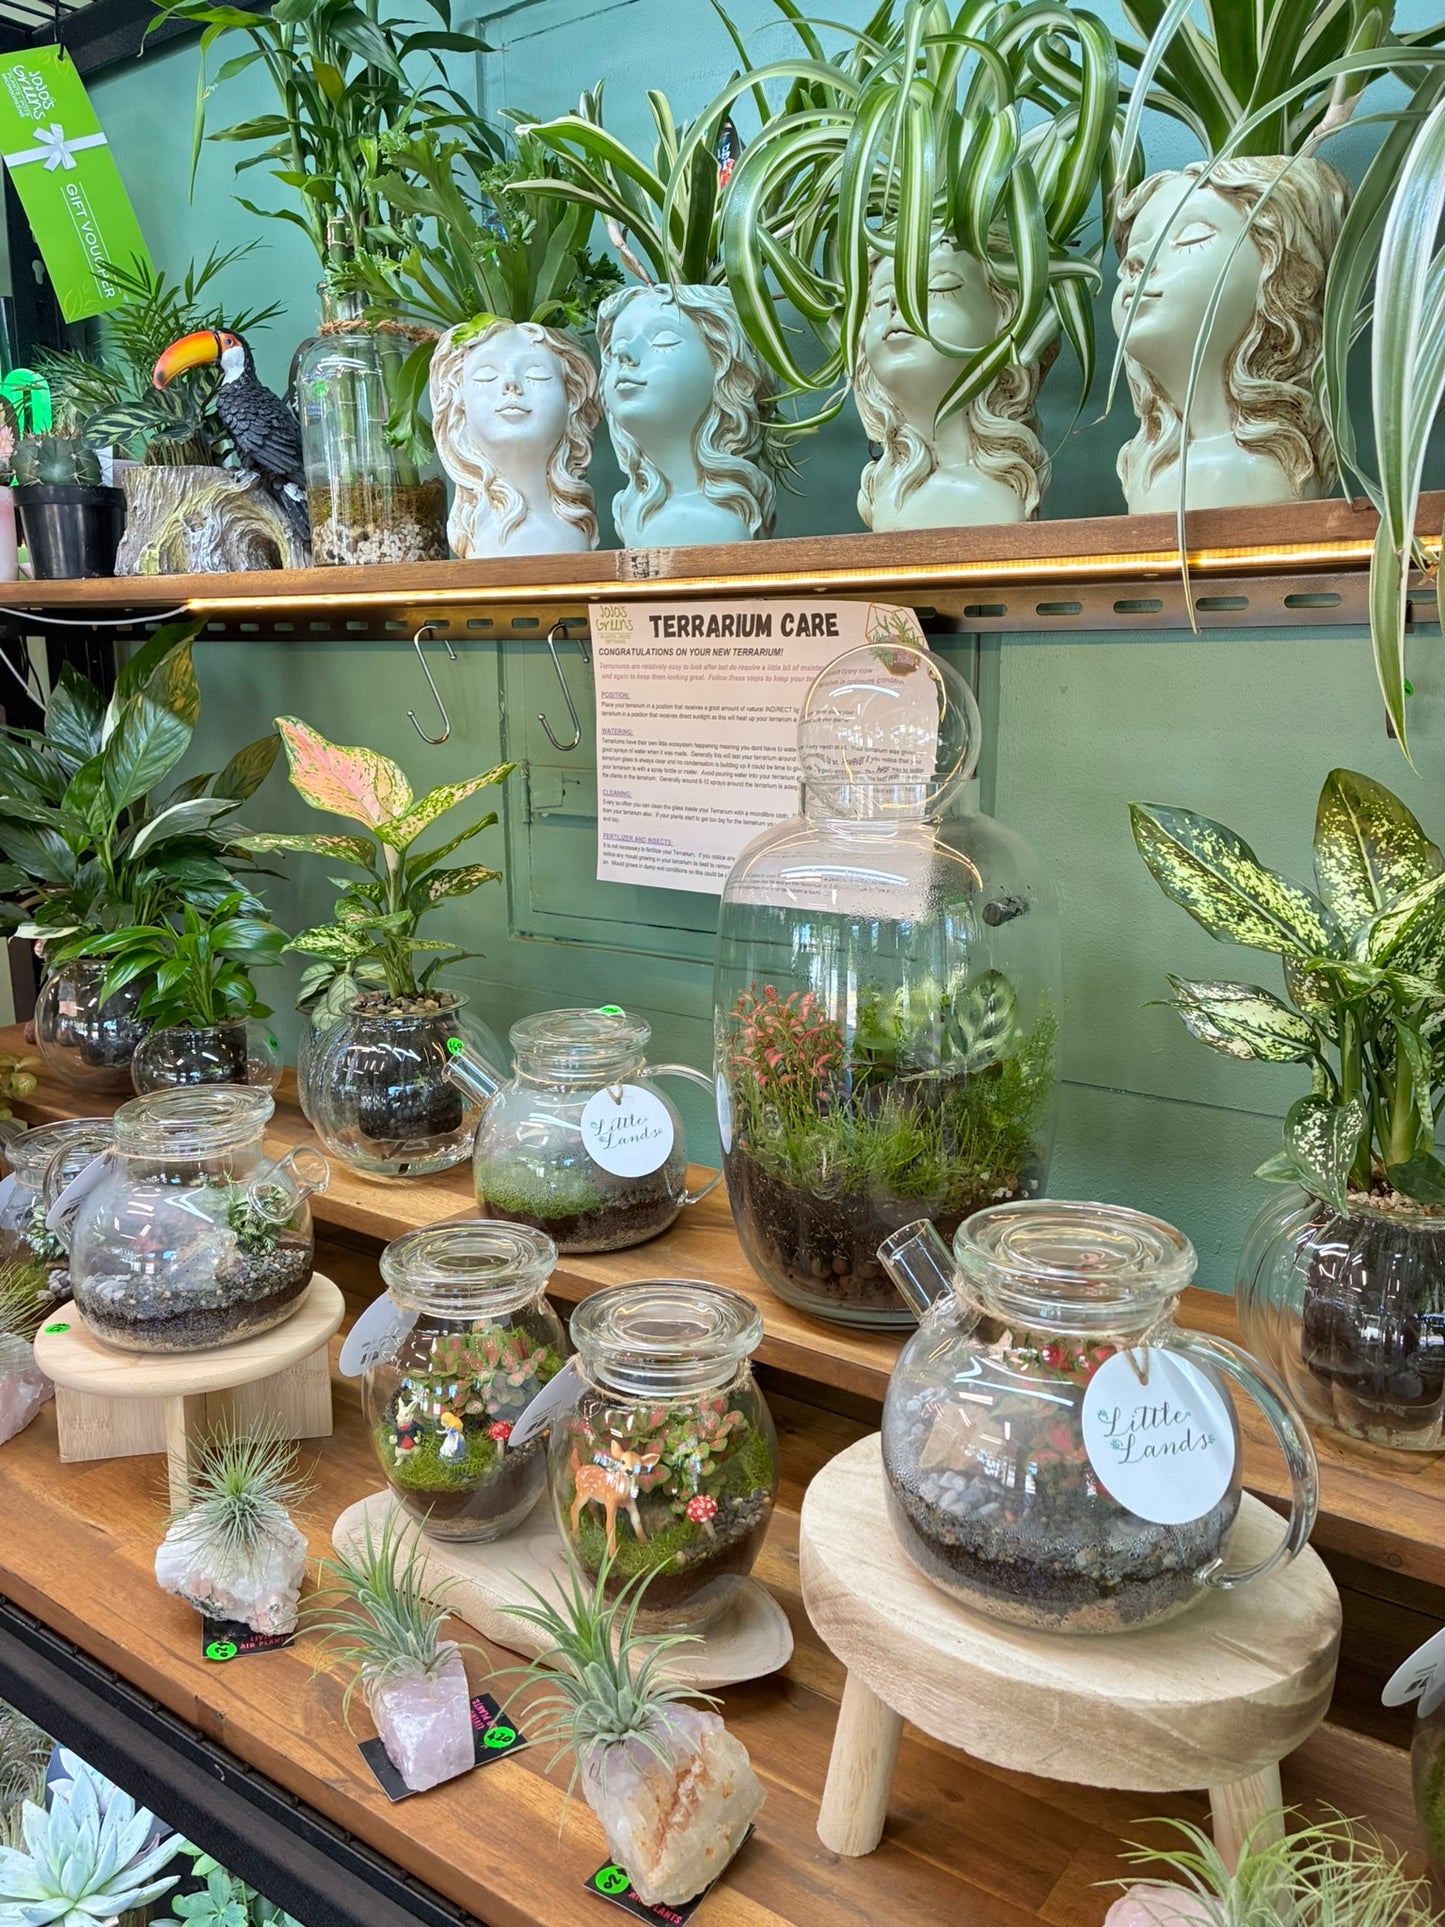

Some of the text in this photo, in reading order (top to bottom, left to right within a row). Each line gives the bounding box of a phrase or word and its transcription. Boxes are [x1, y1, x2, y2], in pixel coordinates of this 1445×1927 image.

[66, 183, 88, 218] GIFT
[648, 612, 840, 638] TERRARIUM CARE
[598, 648, 784, 656] CONGRATULATIONS ON YOUR NEW TERRARIUM!
[641, 663, 667, 671] relatively
[667, 674, 688, 682] looking
[601, 691, 630, 700] POSITION:
[602, 728, 634, 736] WATERING:
[602, 789, 632, 799] CLEANING:
[603, 833, 633, 842] FERTILIZER
[648, 837, 673, 846] INSECTS:
[592, 1114, 648, 1136] Little
[600, 1127, 662, 1150] Lands
[1098, 1401, 1191, 1437] Little
[1111, 1428, 1215, 1464] Lands
[652, 1904, 682, 1925] LANTS
